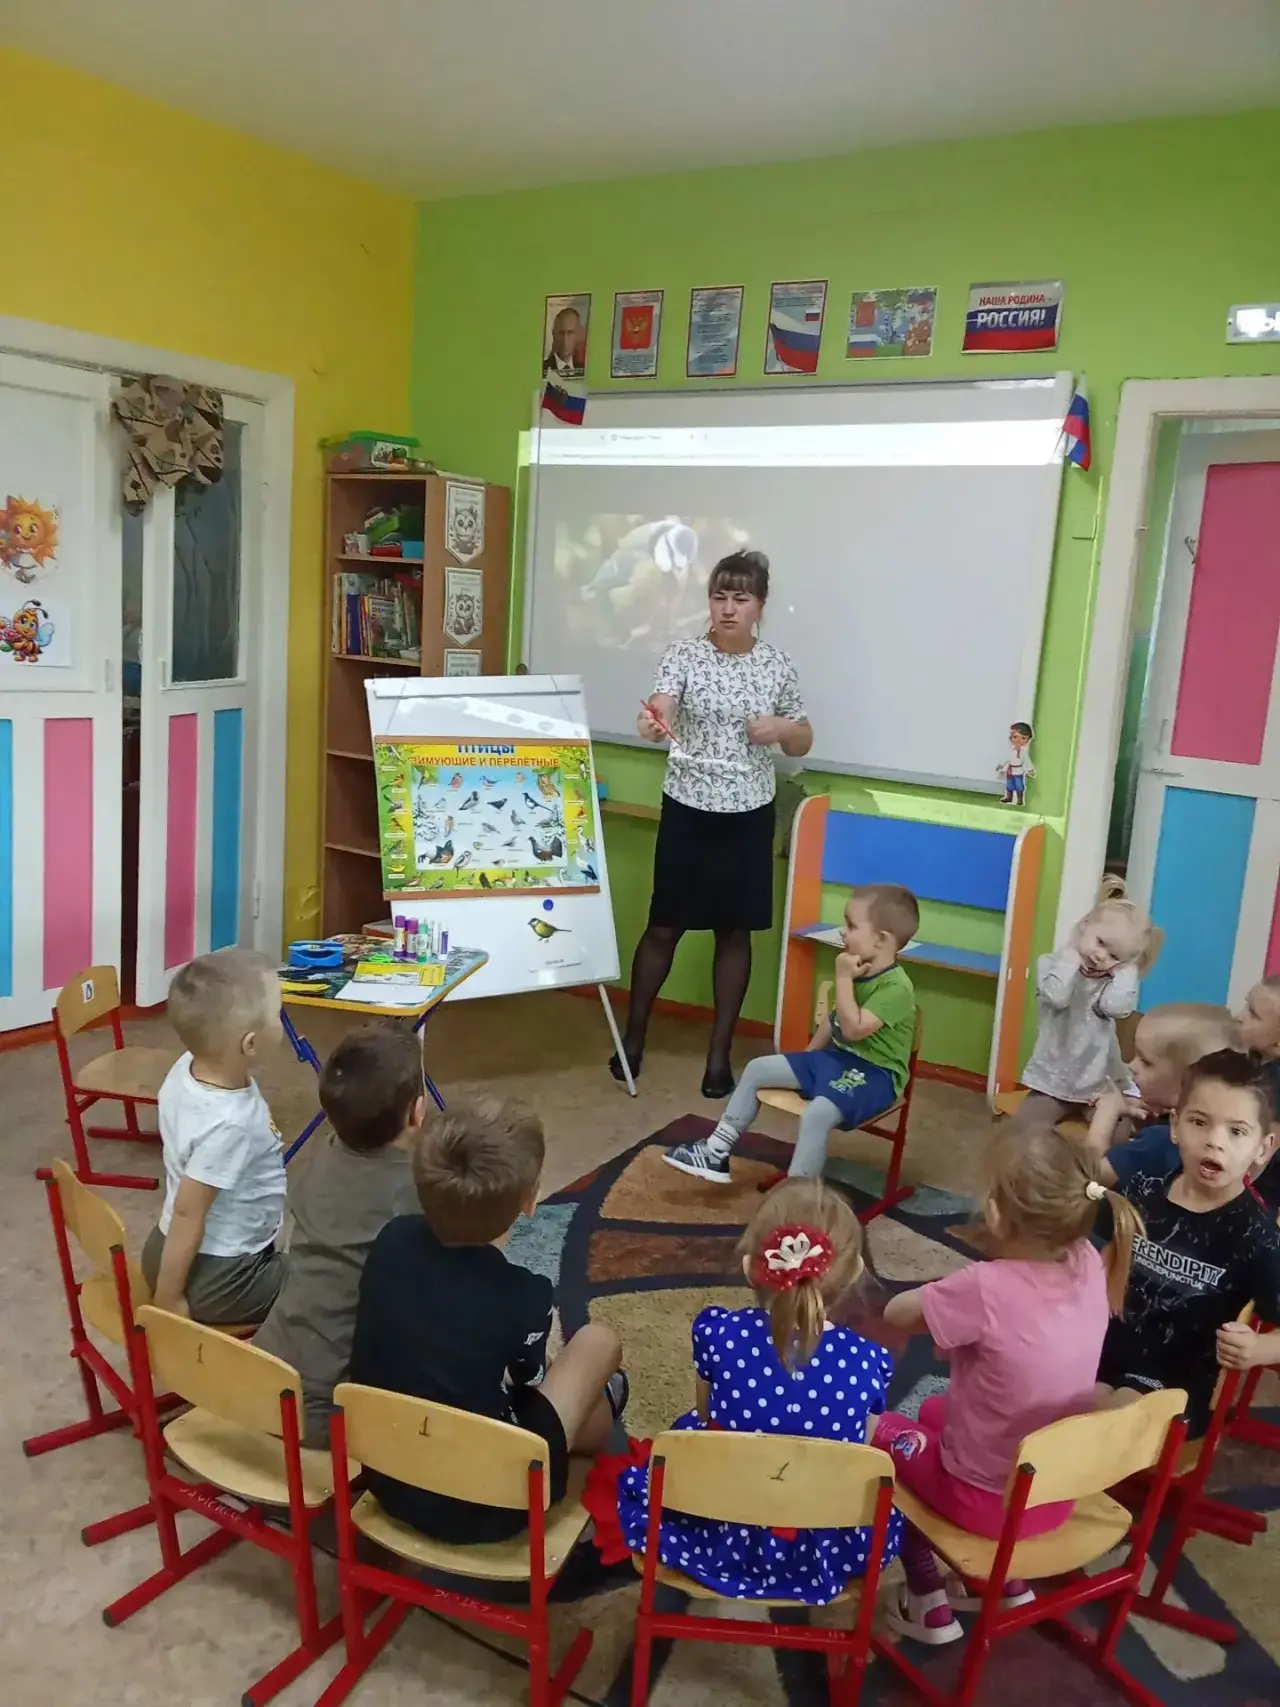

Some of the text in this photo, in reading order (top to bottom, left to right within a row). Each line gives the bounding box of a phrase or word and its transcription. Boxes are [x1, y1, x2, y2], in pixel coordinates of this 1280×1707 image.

[980, 294, 1046, 305] НАША РОДИНА
[976, 309, 1046, 328] РОССИЯ!
[458, 744, 515, 755] ПТИЦЫ
[412, 756, 476, 767] ЗИМУЮЩИЕ
[479, 757, 487, 767] И
[1132, 1233, 1226, 1286] ERENDIPITY
[418, 1416, 431, 1437] 1
[769, 1461, 789, 1482] 1
